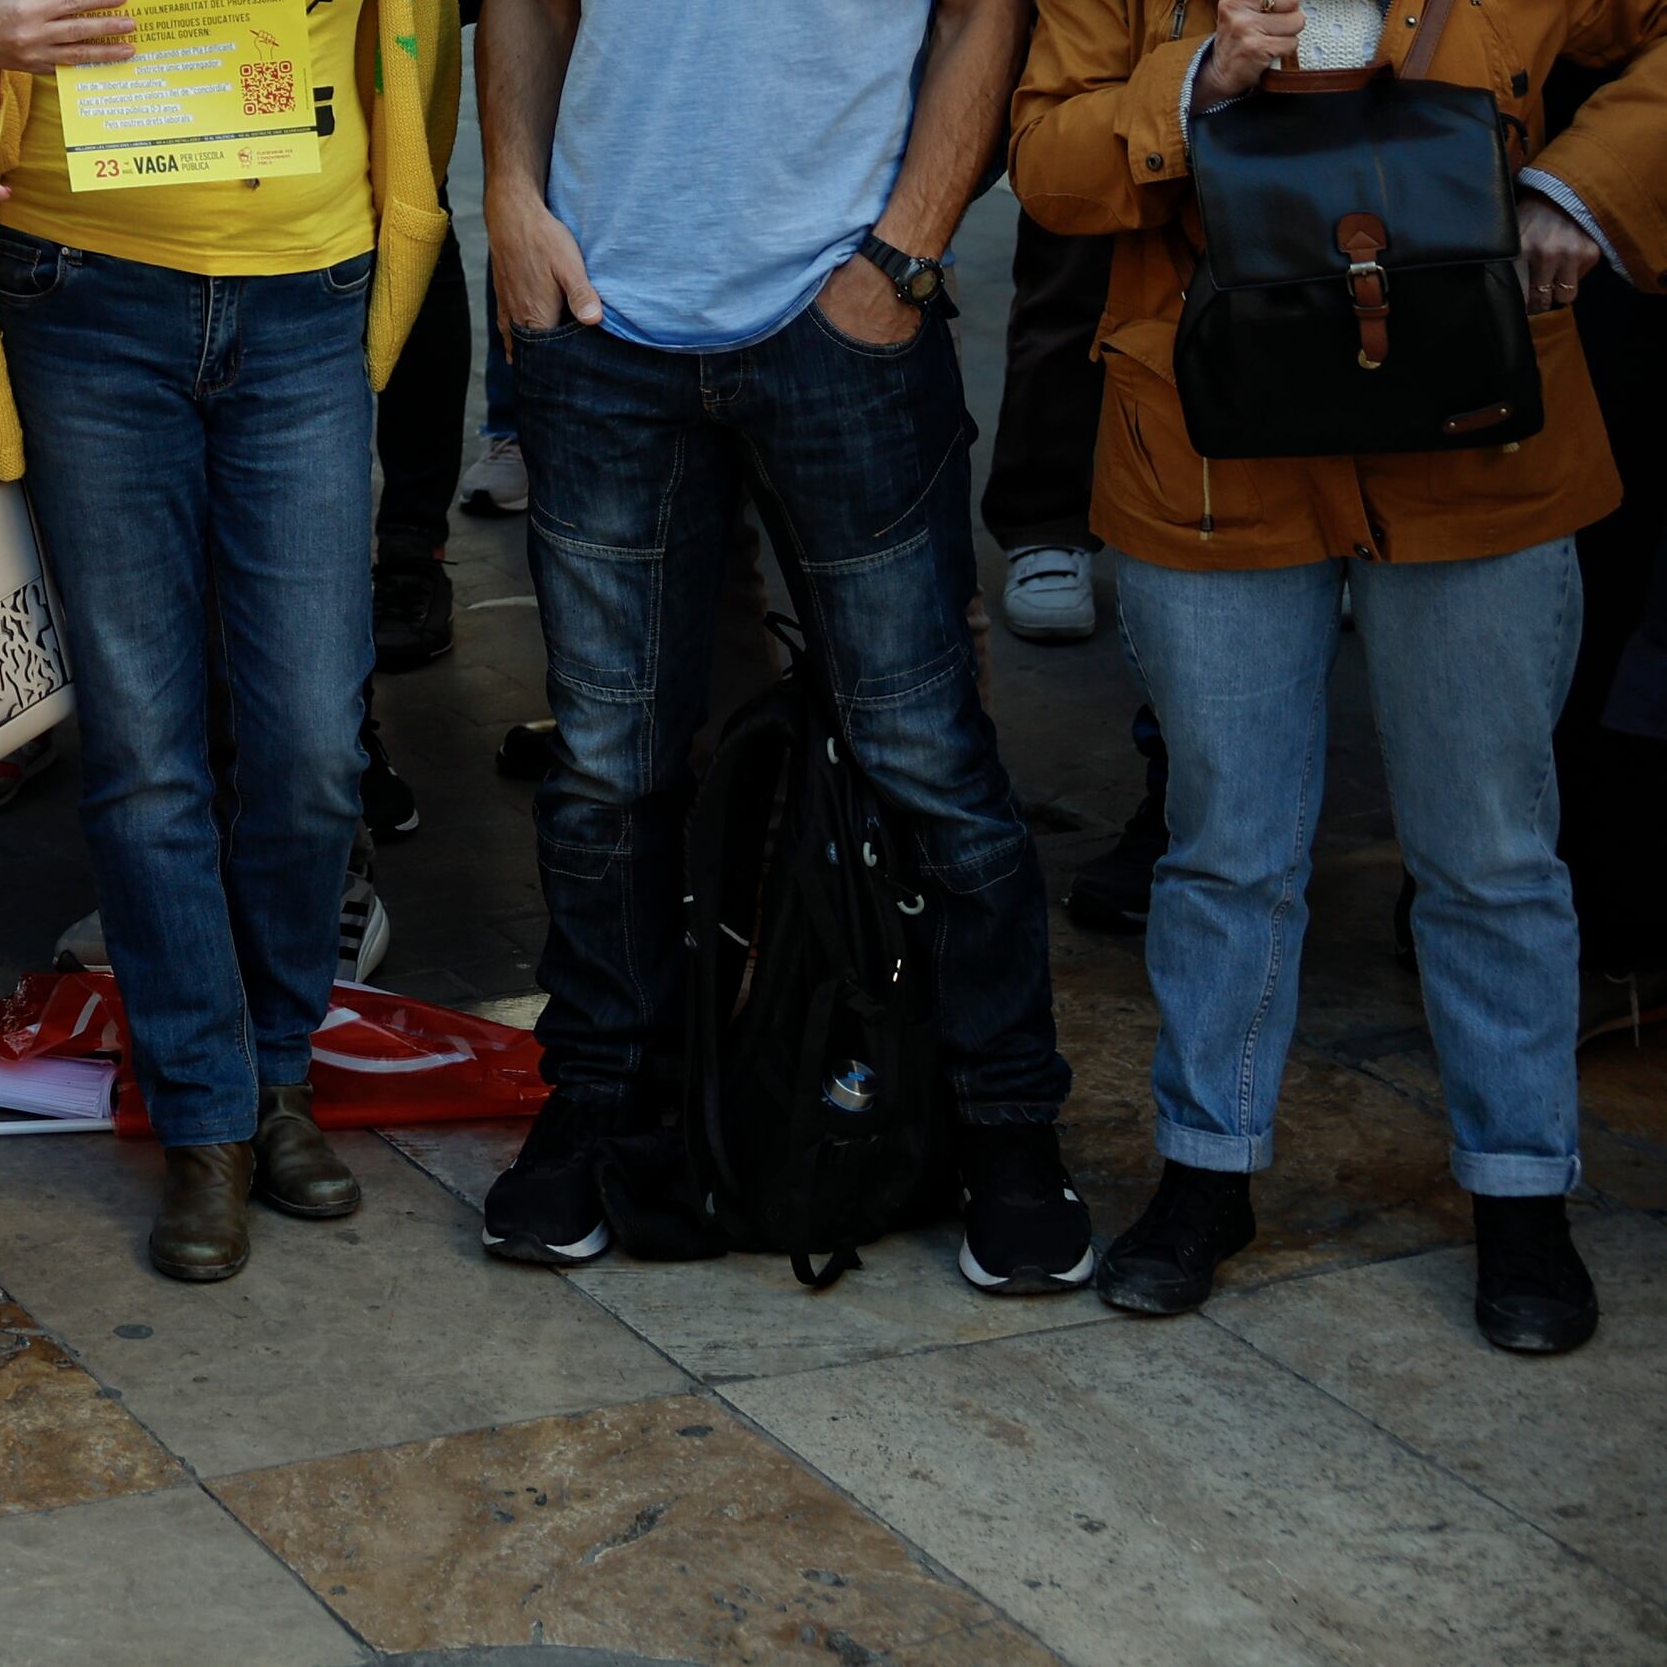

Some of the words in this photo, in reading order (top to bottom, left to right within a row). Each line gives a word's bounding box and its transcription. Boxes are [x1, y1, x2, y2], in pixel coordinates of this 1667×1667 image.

[143, 0, 209, 16] VULNERABILITAT
[201, 12, 251, 27] EDUCATIVES
[94, 158, 120, 179] 23
[132, 153, 180, 175] VAGA
